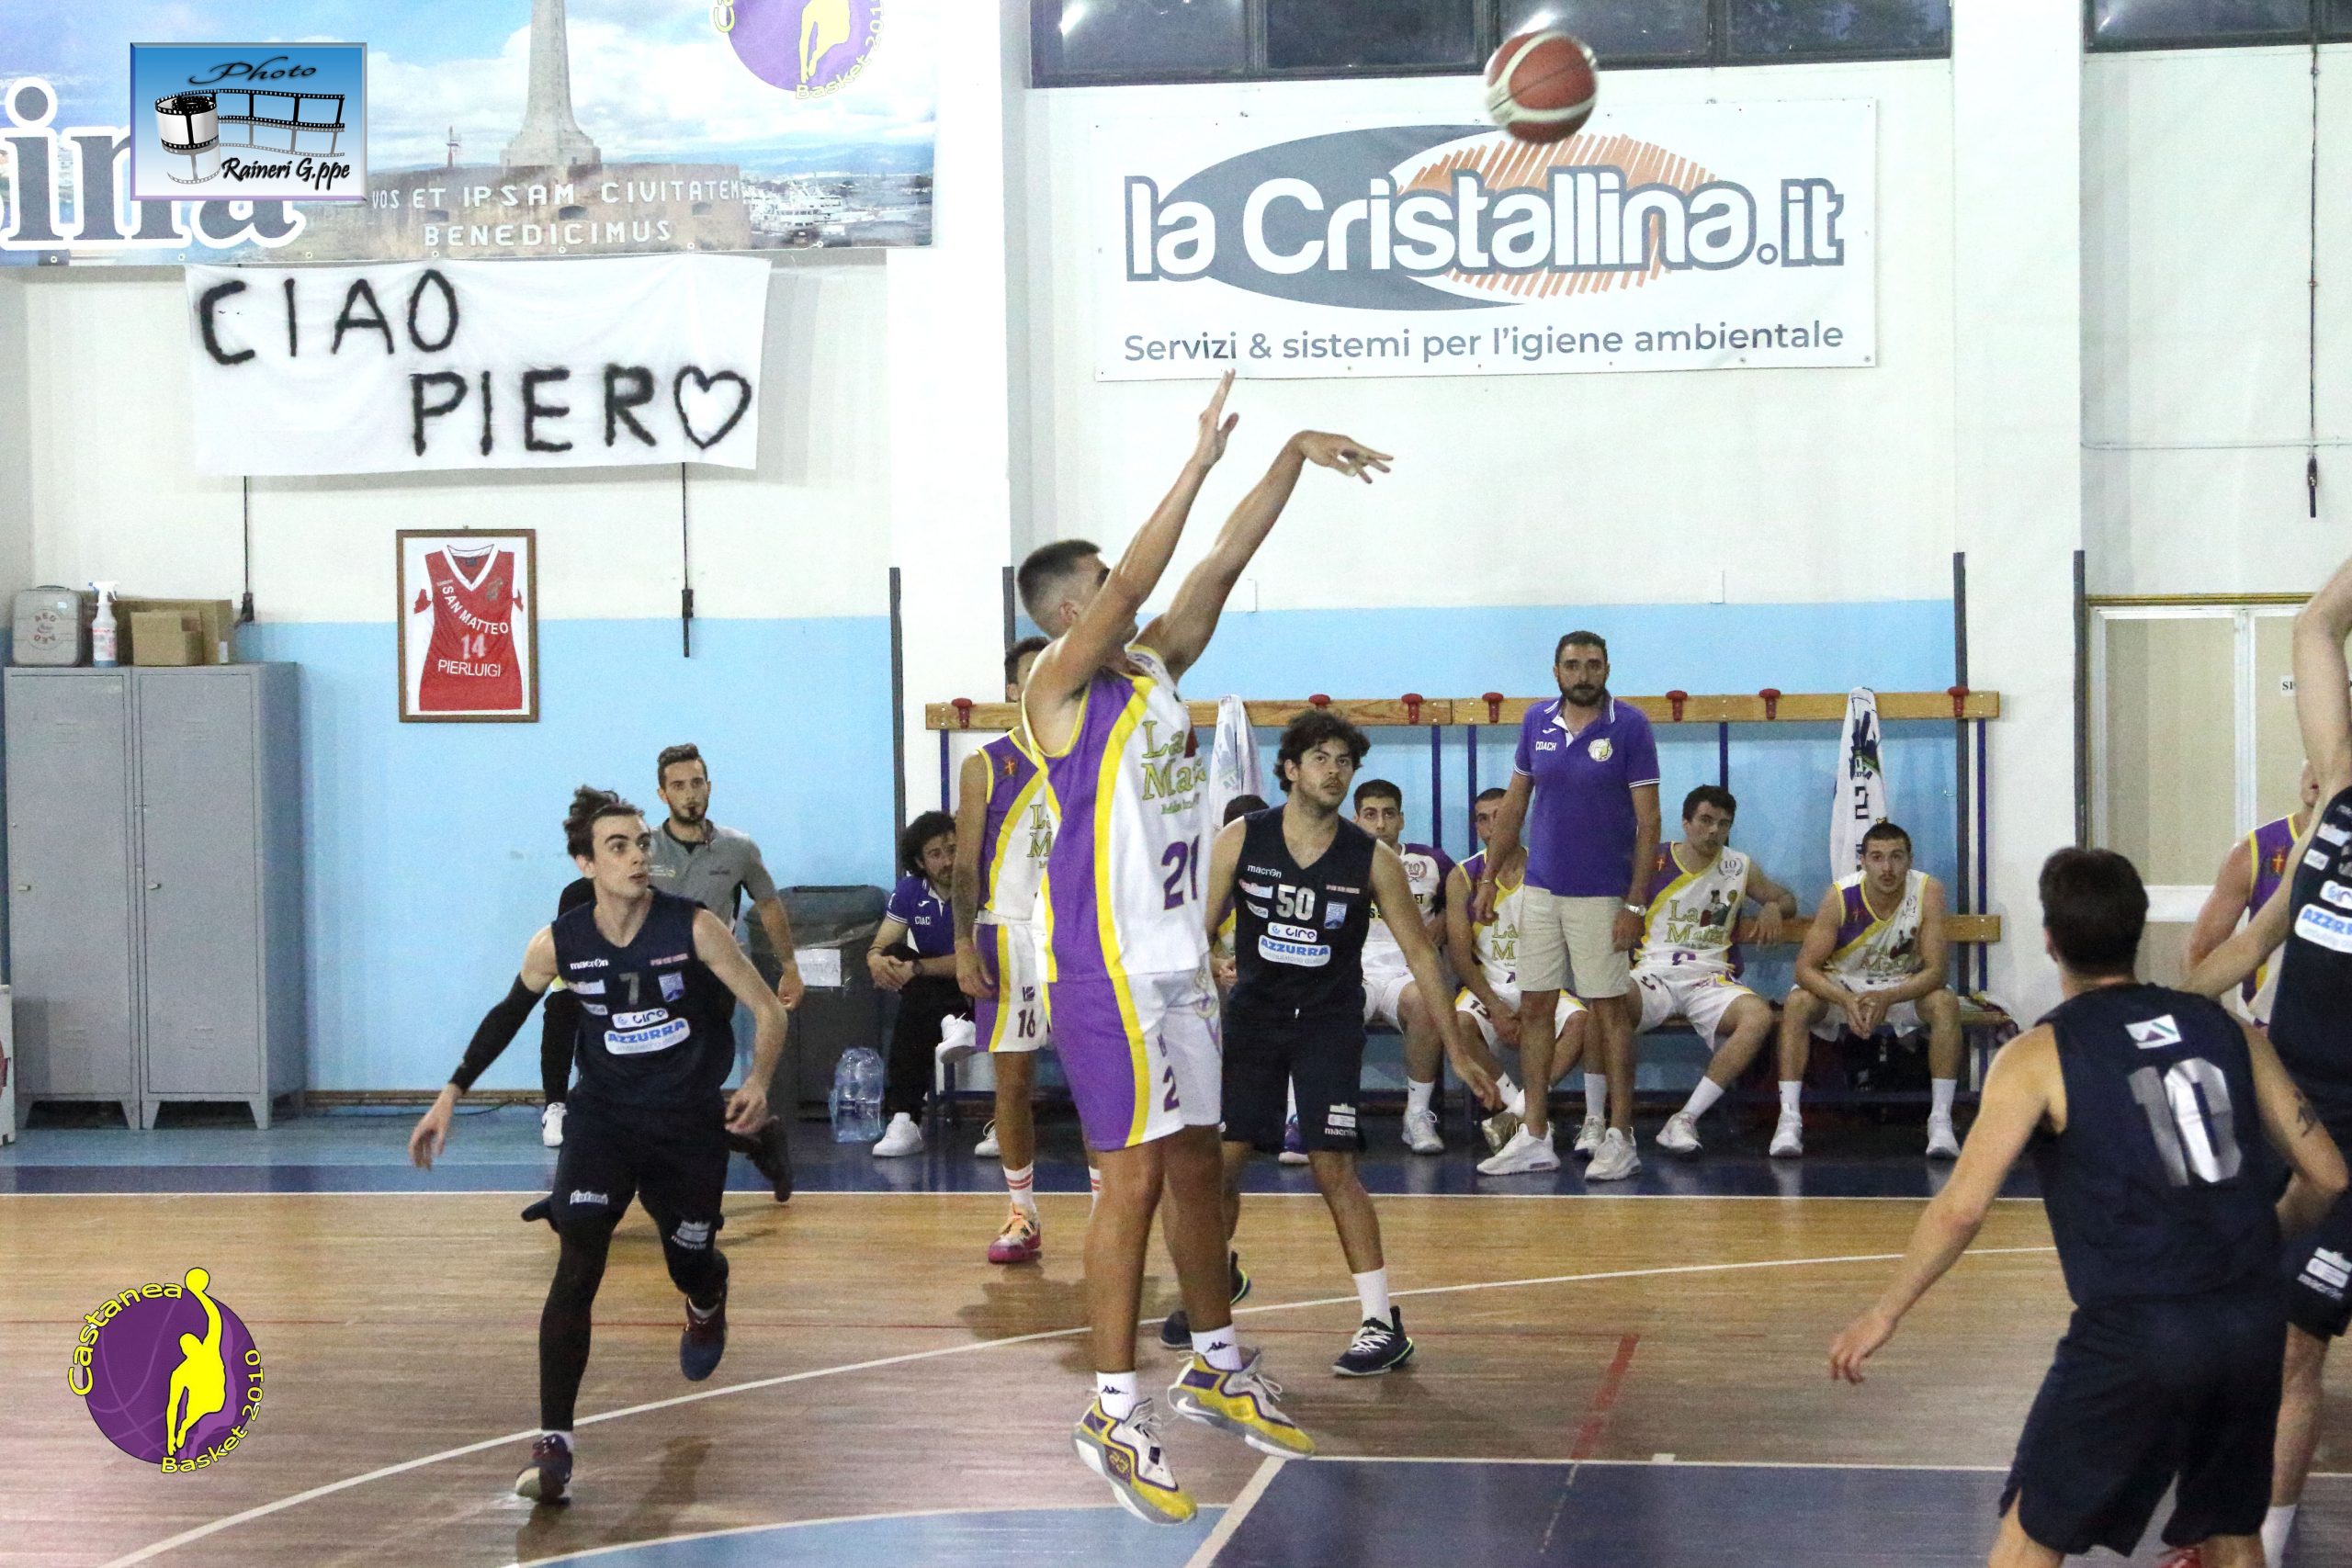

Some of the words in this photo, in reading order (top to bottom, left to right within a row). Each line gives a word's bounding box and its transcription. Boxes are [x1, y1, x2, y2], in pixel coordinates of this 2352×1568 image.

[796, 54, 872, 99] Basket
[372, 189, 400, 209] VOS
[413, 188, 447, 209] ET
[464, 185, 574, 208] IPSAM
[424, 220, 671, 246] BENEDICIMUS
[1125, 175, 1218, 281] la
[1239, 164, 1844, 276] Cristallina.it
[199, 269, 458, 365] CIAO
[1125, 332, 1237, 361] Servizi
[1249, 333, 1272, 359] &
[1283, 328, 1409, 358] sistemi
[1423, 334, 1481, 363] per
[1494, 326, 1623, 361] l'igiene
[1634, 320, 1843, 353] ambientale
[442, 585, 463, 614] SAN
[459, 609, 509, 635] MATTEO
[461, 633, 486, 660] 14
[438, 659, 502, 678] PIERLUIGI
[1141, 720, 1184, 758] La
[1535, 740, 1556, 751] COACH
[1161, 834, 1200, 909] 21
[1248, 864, 1282, 878] macron
[1276, 884, 1316, 920] 50
[1668, 900, 1699, 923] La
[1261, 937, 1329, 956] AZZURRA
[570, 958, 609, 970] macron
[618, 972, 640, 1005] 7
[608, 1021, 685, 1043] AZZURRA
[1018, 1009, 1036, 1038] 16
[2127, 1057, 2242, 1186] 10
